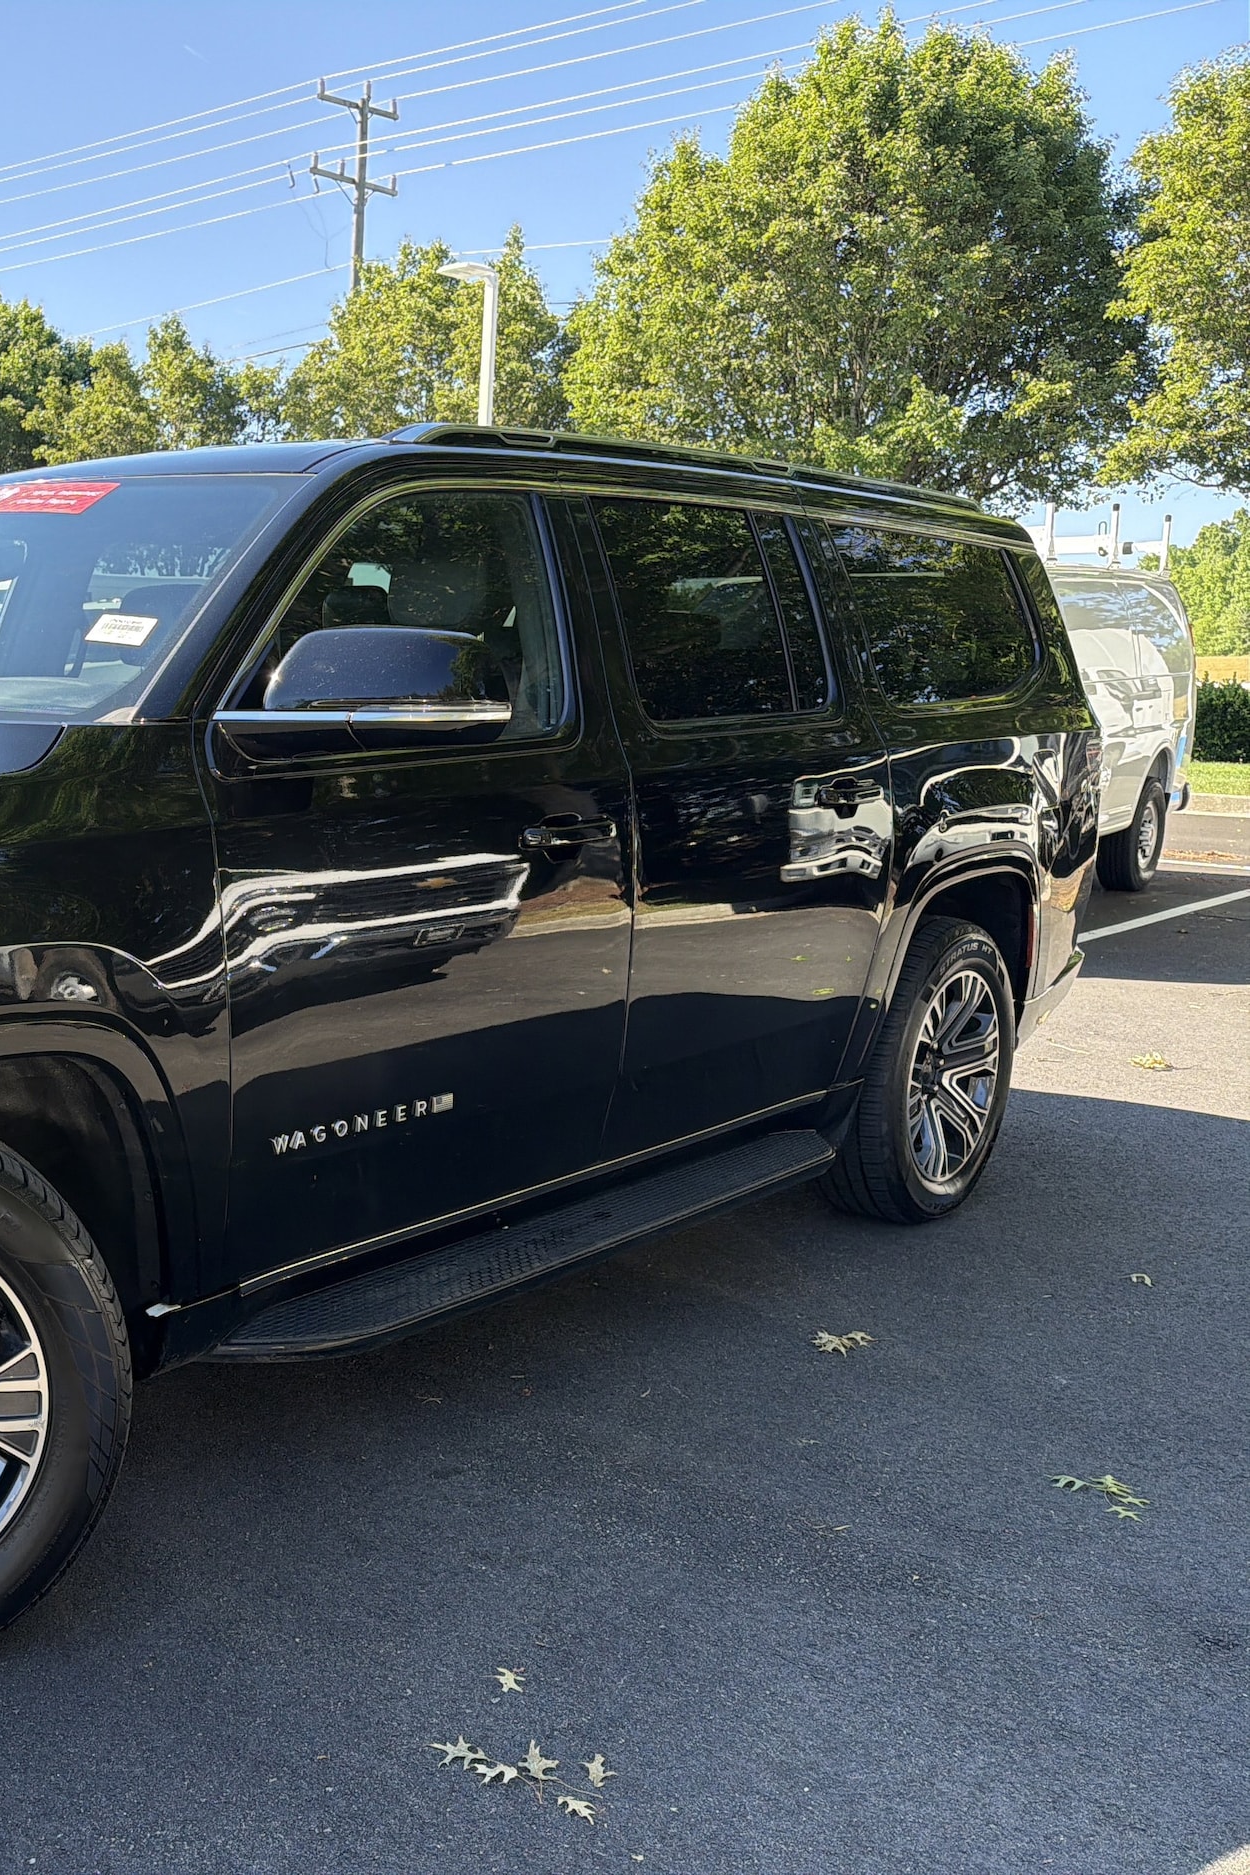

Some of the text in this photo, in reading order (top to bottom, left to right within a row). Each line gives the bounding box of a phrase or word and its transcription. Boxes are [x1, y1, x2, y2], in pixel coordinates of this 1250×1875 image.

[939, 942, 993, 976] STRATUS HT
[269, 1099, 427, 1155] WAGONEER
